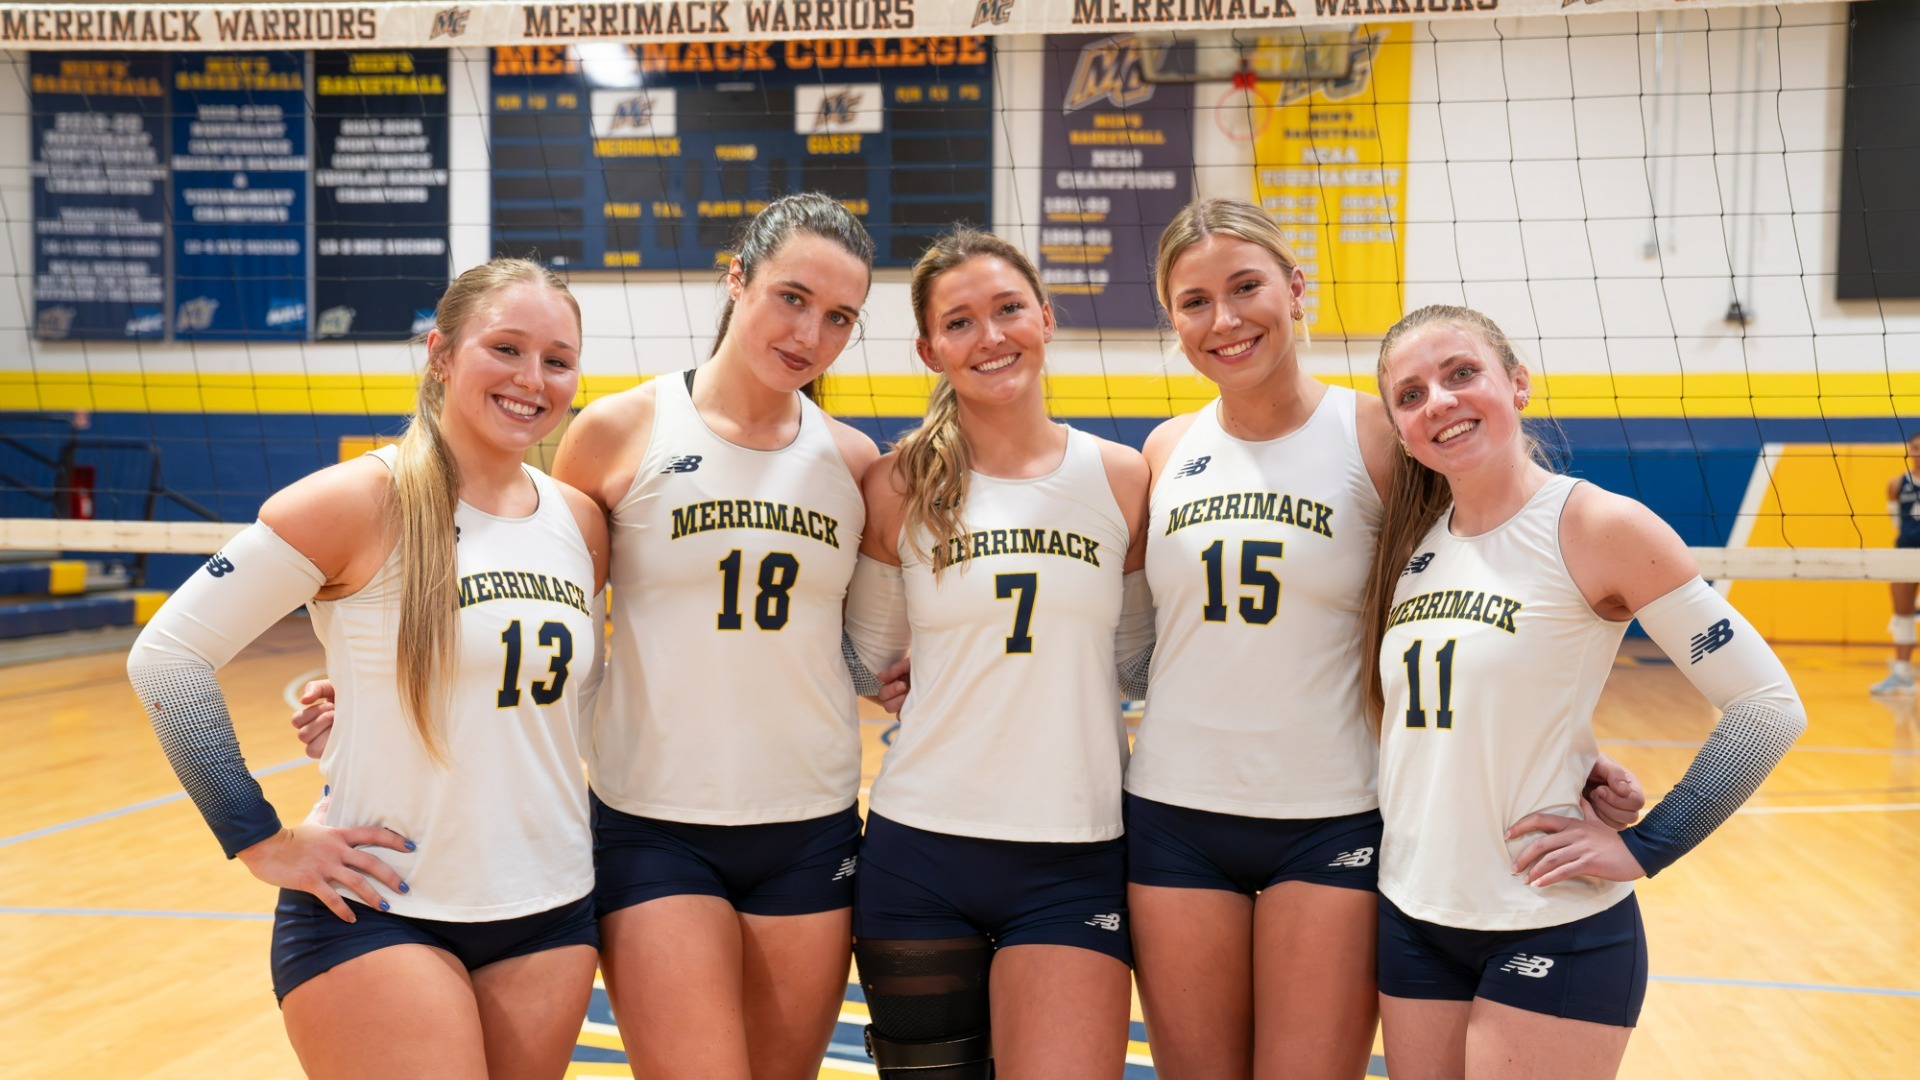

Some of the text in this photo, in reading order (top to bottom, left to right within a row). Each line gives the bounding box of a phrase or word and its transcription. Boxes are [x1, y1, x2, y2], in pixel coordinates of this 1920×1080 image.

[1, 8, 376, 42] MERRIMACK WARRIORS
[523, 0, 914, 37] MERRIMACK WARRIORS
[785, 36, 987, 69] COLLEGE
[807, 133, 862, 154] GUEST
[1056, 171, 1176, 189] CHAMPIONS
[671, 499, 840, 550] MERRIMACK
[1164, 492, 1334, 539] MERRIMACK
[716, 548, 800, 631] 18
[1200, 538, 1285, 627] 15
[994, 571, 1039, 656] 7
[1383, 590, 1522, 635] MERRIMACK
[496, 619, 573, 710] 13
[1402, 638, 1457, 731] 11
